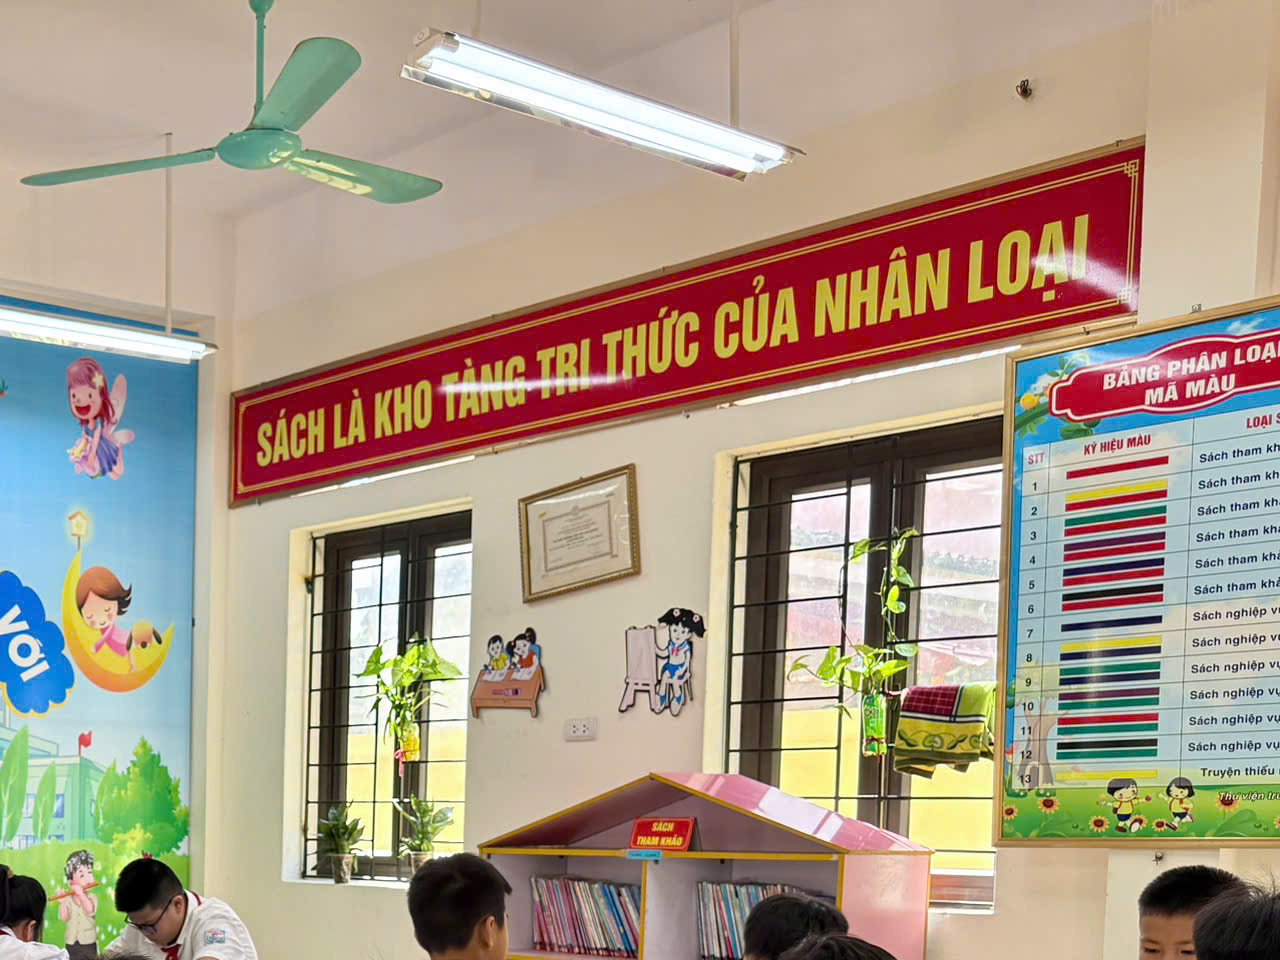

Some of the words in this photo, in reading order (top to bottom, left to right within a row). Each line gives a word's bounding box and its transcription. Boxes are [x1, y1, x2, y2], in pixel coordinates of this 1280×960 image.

[256, 406, 325, 468] SÁCH
[333, 388, 366, 449] LÀ
[375, 379, 433, 440] KHO
[441, 355, 526, 423] TÀNG
[536, 337, 590, 400] TRI
[602, 306, 700, 383] THỨC
[713, 274, 799, 359] CỦA
[814, 245, 952, 338] NHÂN
[968, 213, 1090, 303] LOẠI
[1103, 363, 1161, 391] BẢNG
[1167, 351, 1228, 379] PHÂN
[1144, 381, 1179, 407] MÃ
[1185, 373, 1236, 399] MÀU
[1246, 414, 1273, 429] LOẠI
[1100, 438, 1124, 454] HIỆU
[1127, 433, 1151, 449] MÀU
[1027, 452, 1045, 465] STT
[1199, 450, 1228, 463] Sách
[1232, 447, 1262, 458] tham
[1033, 481, 1038, 491] 1
[1198, 477, 1227, 489] Sách
[1231, 473, 1261, 485] tham
[1031, 506, 1037, 516] 2
[1197, 504, 1226, 516] Sách
[1230, 501, 1260, 512] tham
[1030, 530, 1037, 540] 3
[1196, 531, 1225, 542] Sách
[1229, 528, 1259, 539] tham
[1030, 555, 1036, 565] 4
[1195, 557, 1224, 569] Sách
[1228, 555, 1258, 566] tham
[1028, 579, 1035, 590] 5
[1194, 583, 1223, 595] Sách
[1227, 582, 1257, 592] tham
[1027, 604, 1034, 614] 6
[1193, 610, 1222, 621] Sách
[1226, 606, 1267, 620] nghiệp
[1027, 629, 1033, 638] 7
[1192, 637, 1221, 648] Sách
[1225, 633, 1266, 647] nghiệp
[1026, 653, 1033, 663] 8
[1191, 663, 1220, 674] Sách
[1224, 660, 1265, 673] nghiệp
[1025, 677, 1032, 687] 9
[1190, 689, 1219, 700] Sách
[1223, 686, 1264, 700] nghiệp
[1022, 702, 1034, 711] 10
[1189, 715, 1218, 726] Sách
[1222, 713, 1263, 726] nghiệp
[1021, 726, 1032, 736] 11
[1188, 741, 1217, 752] Sách
[1221, 740, 1262, 753] nghiệp
[1266, 741, 1280, 750] vụ
[1020, 750, 1032, 760] 12
[1200, 767, 1241, 779] Truyện
[1245, 764, 1275, 776] thiếu
[1019, 774, 1032, 784] 13
[1242, 790, 1265, 802] viện
[651, 820, 675, 832] SÁCH
[636, 836, 659, 846] THAM
[660, 833, 683, 846] KHẢO
